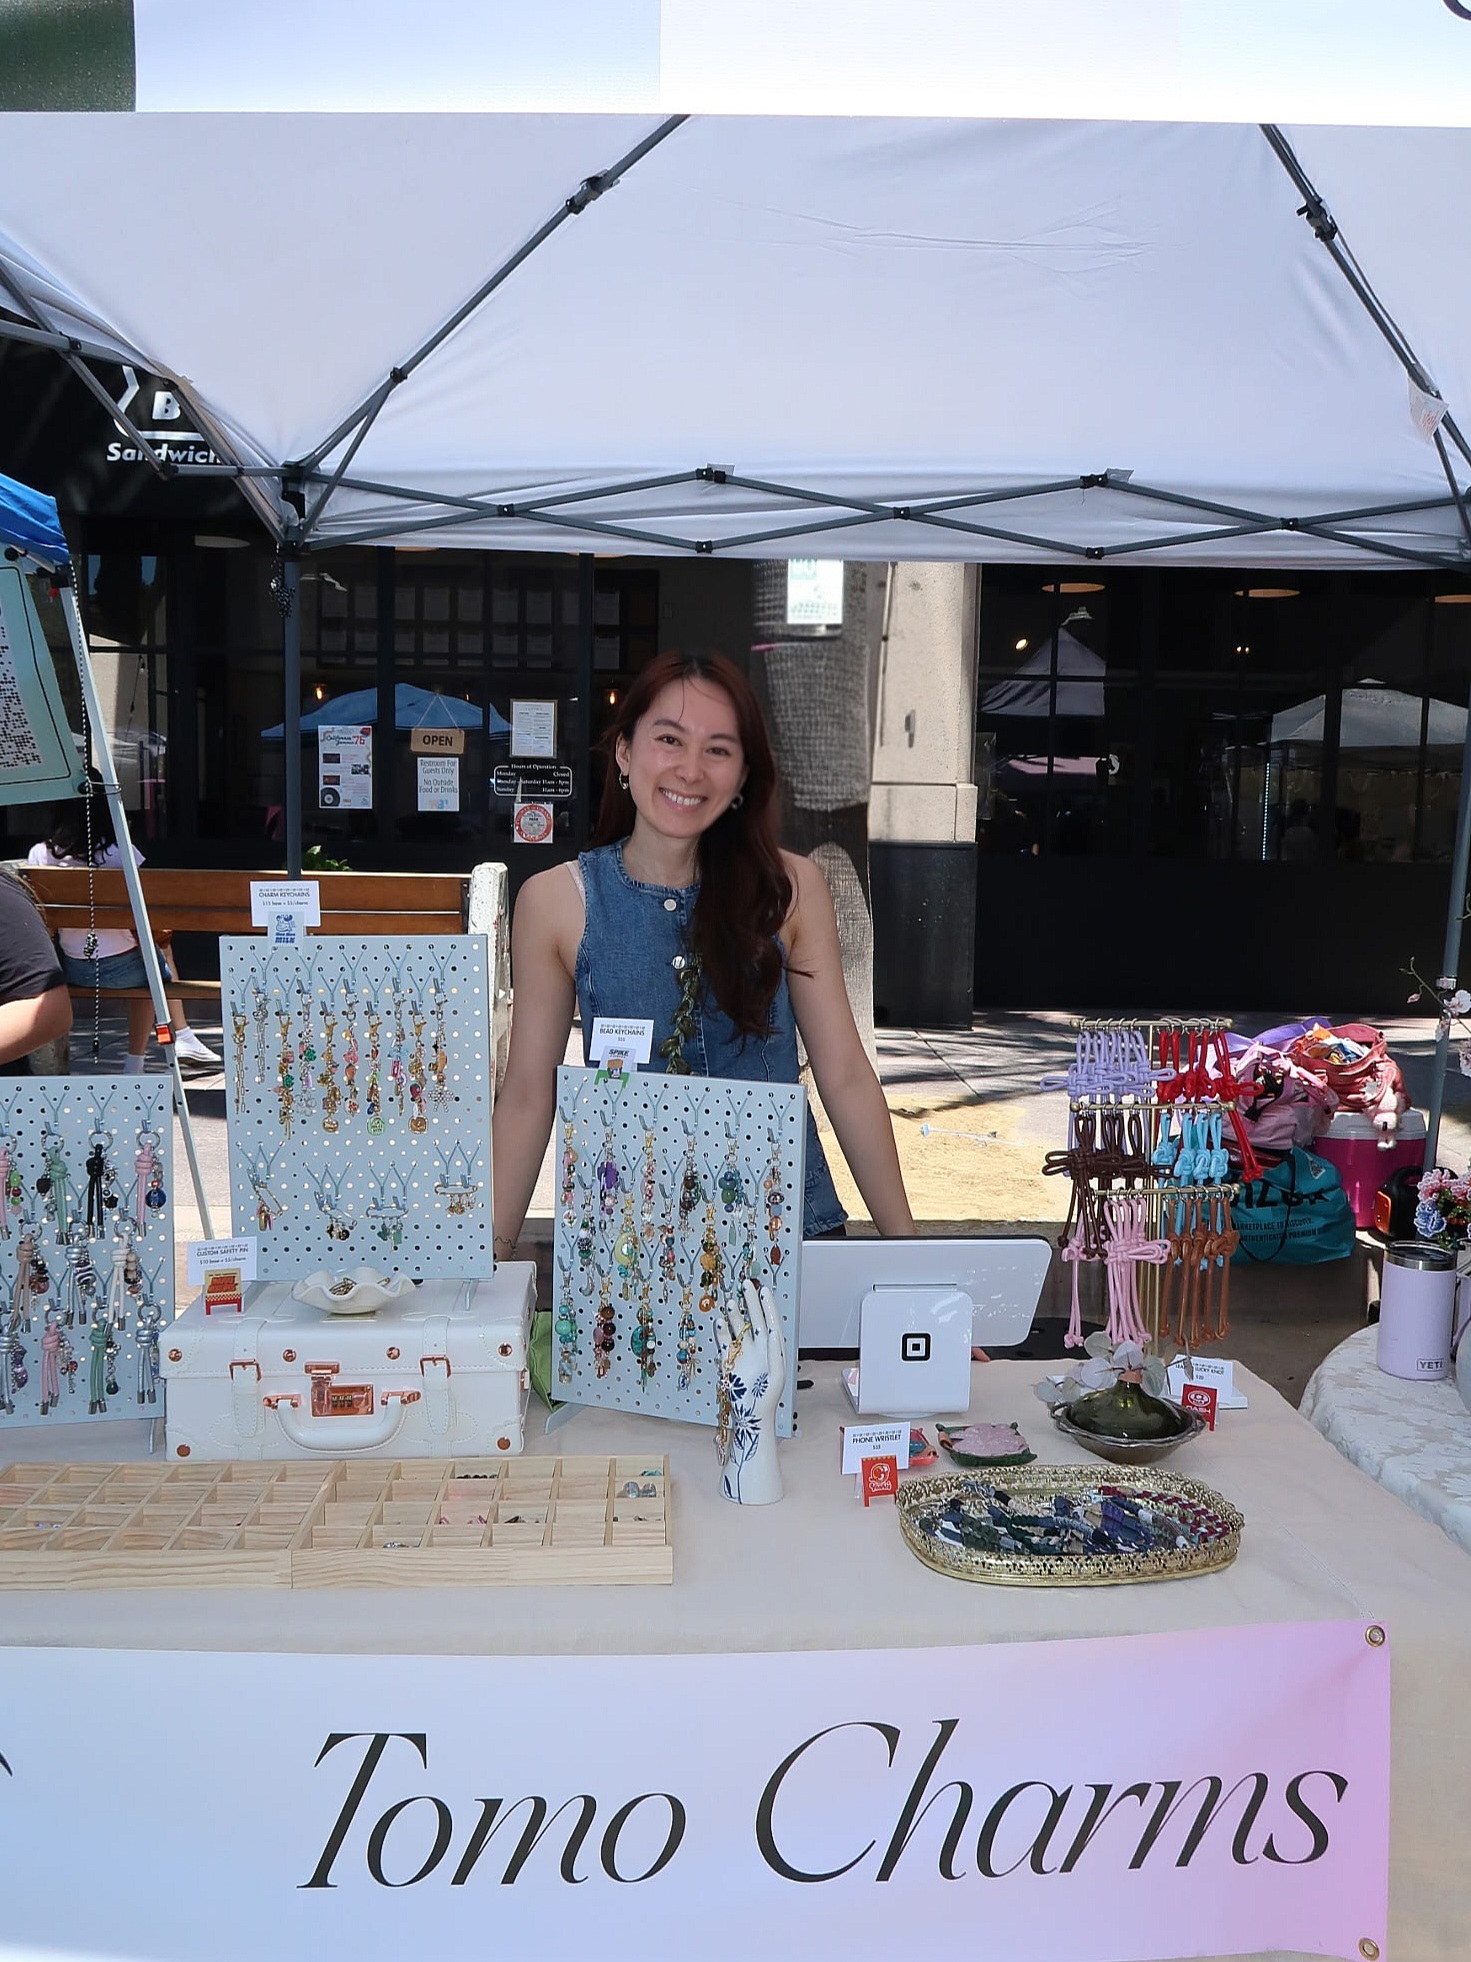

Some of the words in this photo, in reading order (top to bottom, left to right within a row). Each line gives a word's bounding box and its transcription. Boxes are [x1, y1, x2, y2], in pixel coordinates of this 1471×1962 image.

[422, 735, 453, 746] OPEN
[442, 767, 455, 776] Only
[852, 1436, 873, 1444] PHONE
[874, 1434, 901, 1442] WRISTLET
[296, 1733, 686, 1888] Tomo
[755, 1719, 1348, 1883] Charms
